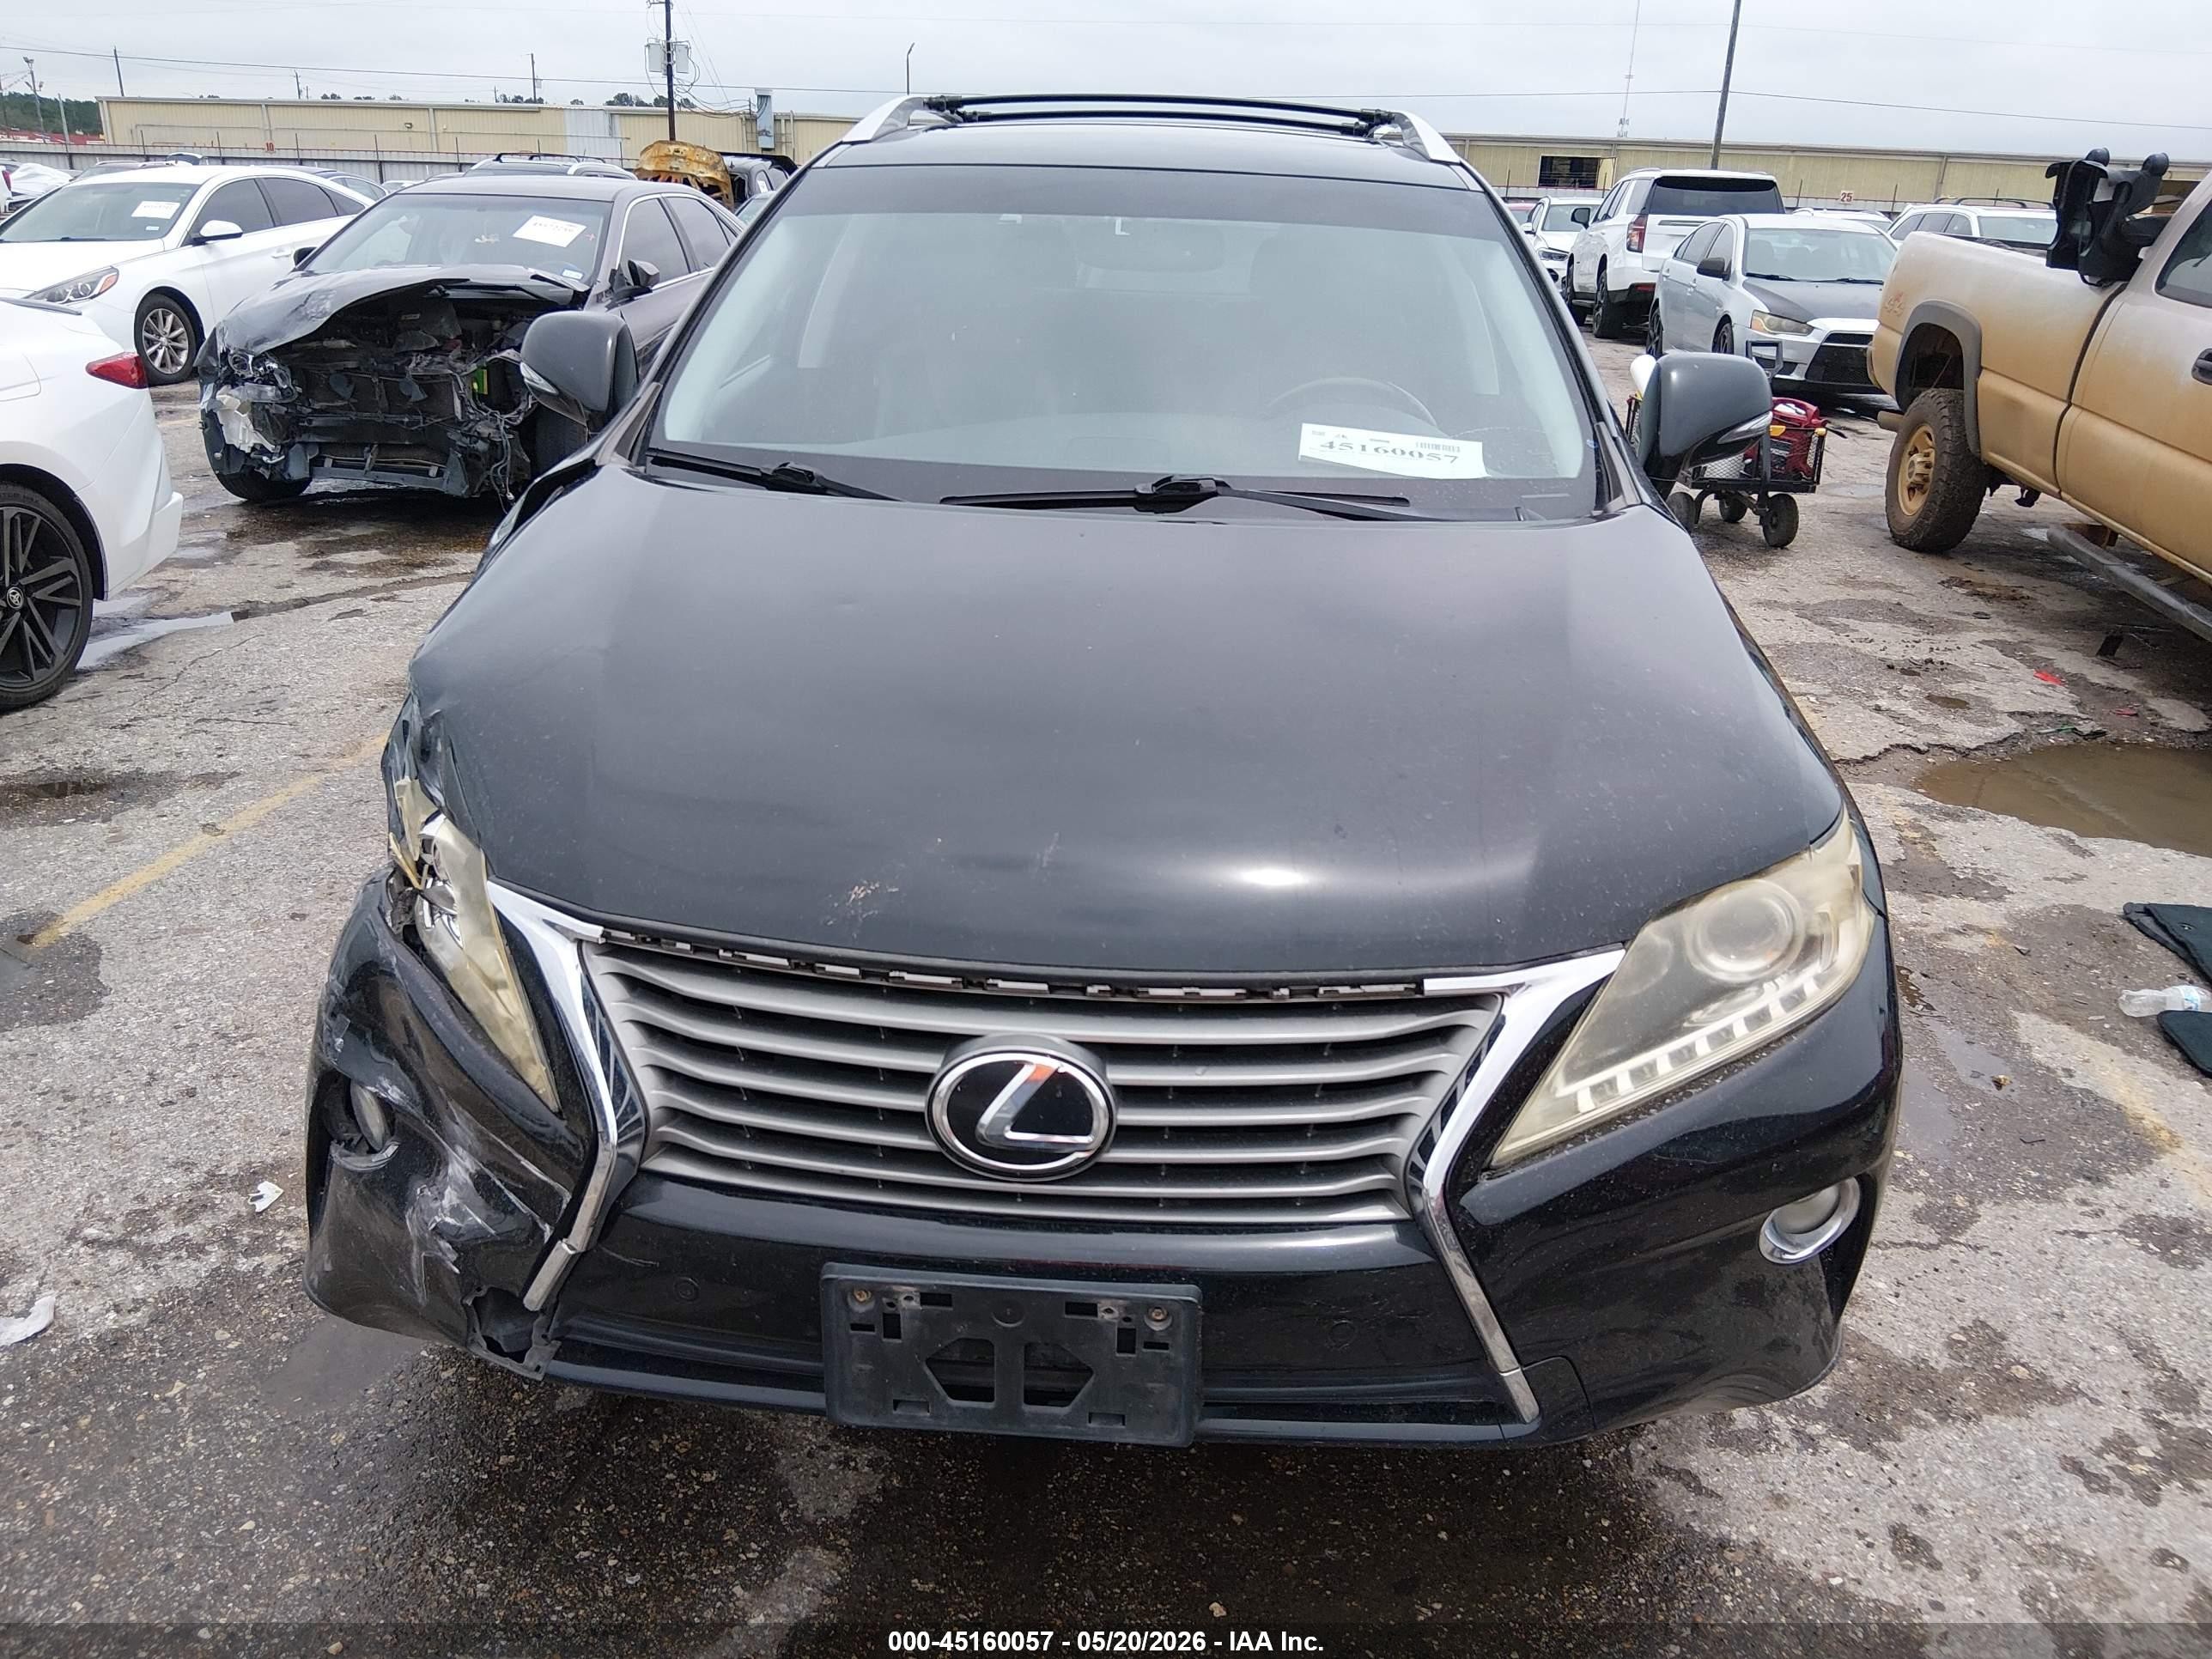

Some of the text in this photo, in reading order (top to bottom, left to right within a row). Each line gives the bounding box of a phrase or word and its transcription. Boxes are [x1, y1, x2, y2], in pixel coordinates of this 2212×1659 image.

[265, 142, 275, 152] 10
[1840, 191, 1854, 203] 25
[1320, 441, 1460, 464] 45160057
